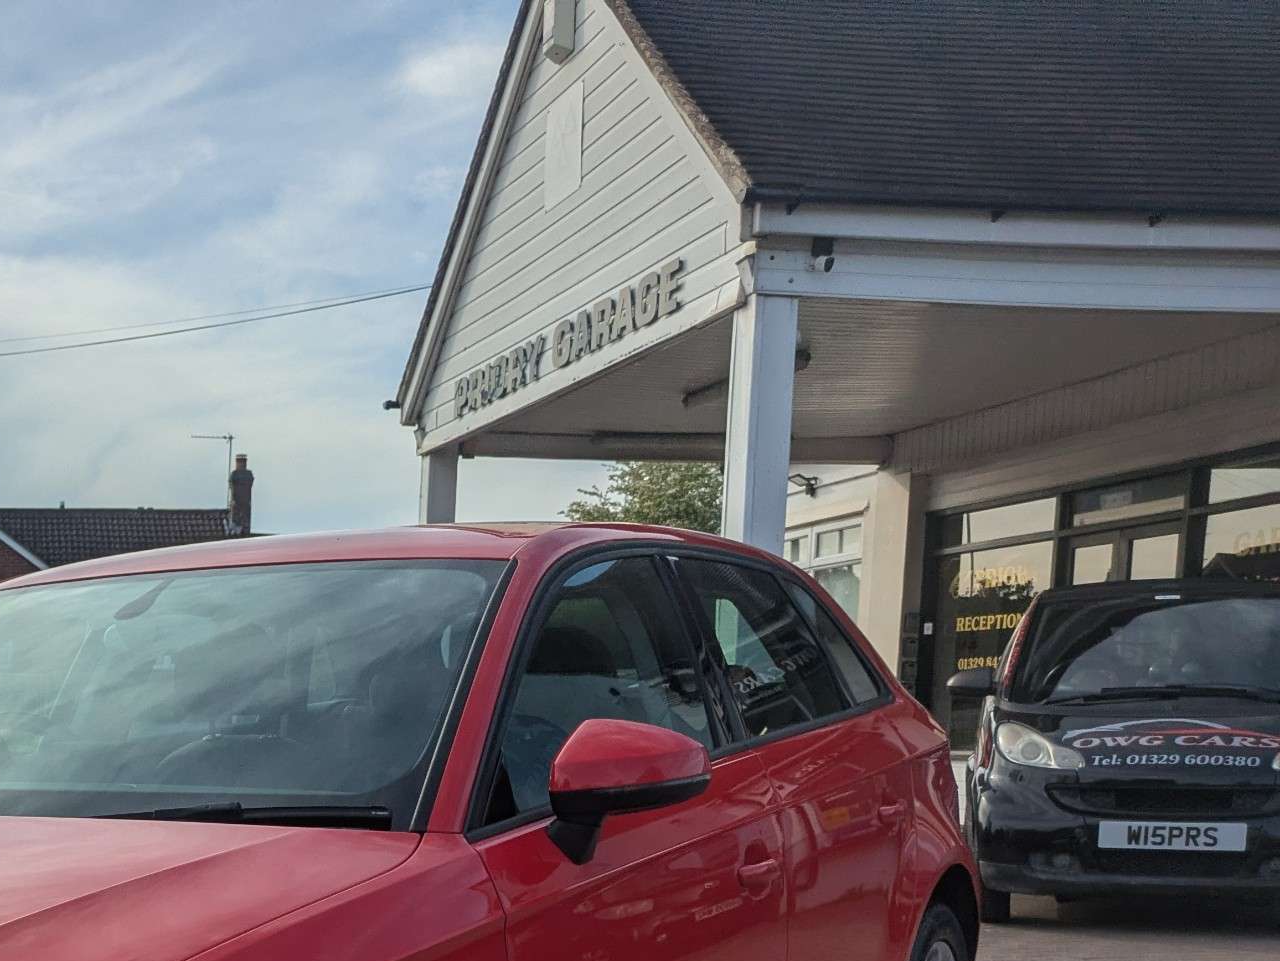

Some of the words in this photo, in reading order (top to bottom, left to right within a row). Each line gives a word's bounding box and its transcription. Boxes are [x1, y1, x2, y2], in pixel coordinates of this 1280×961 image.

[552, 256, 682, 369] GARAGE
[1071, 735, 1165, 749] OWG
[1174, 735, 1280, 749] CARS
[1091, 755, 1122, 766] Tel:
[1126, 754, 1180, 766] 01329
[1184, 754, 1261, 767] 600380
